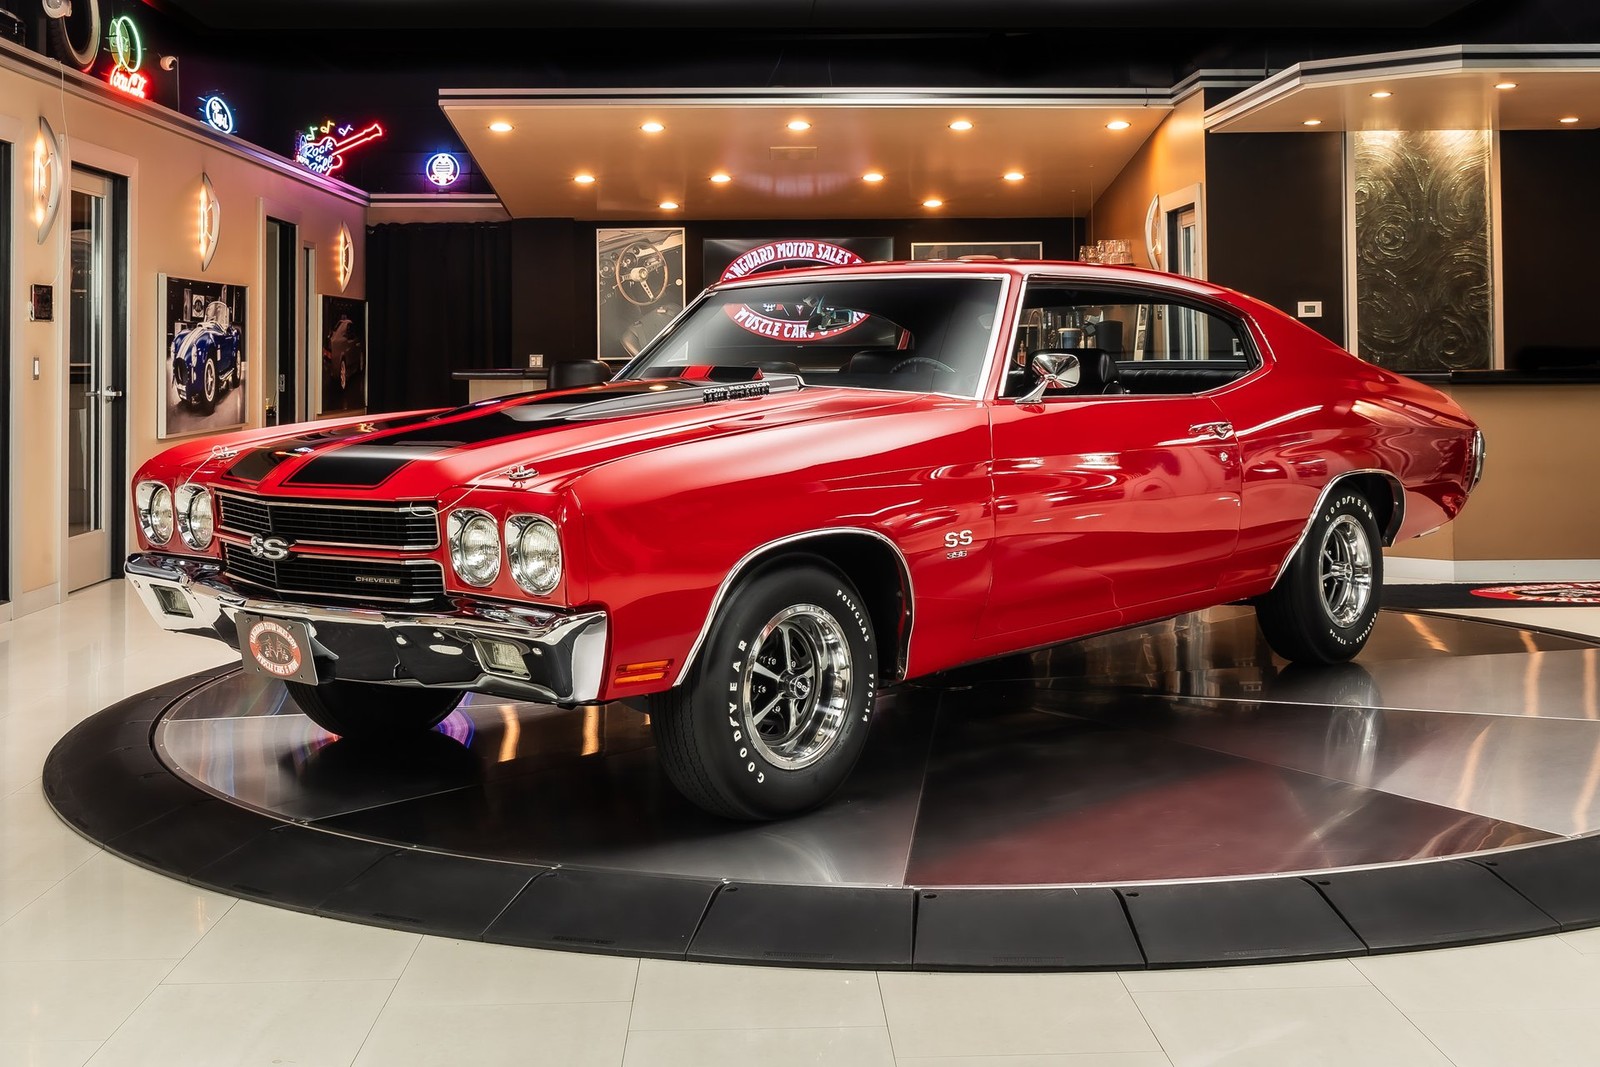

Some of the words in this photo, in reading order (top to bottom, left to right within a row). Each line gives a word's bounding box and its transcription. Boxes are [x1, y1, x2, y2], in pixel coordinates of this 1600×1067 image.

[304, 138, 334, 158] Rock
[775, 242, 815, 259] MOTOR
[733, 306, 782, 337] MUSCLE
[1325, 495, 1373, 522] GOODYEAR
[250, 533, 289, 559] SS
[944, 529, 973, 548] SS
[355, 576, 401, 585] CHEVELLE
[836, 589, 870, 642] POLYGLAS
[729, 639, 765, 784] GOODYEAR
